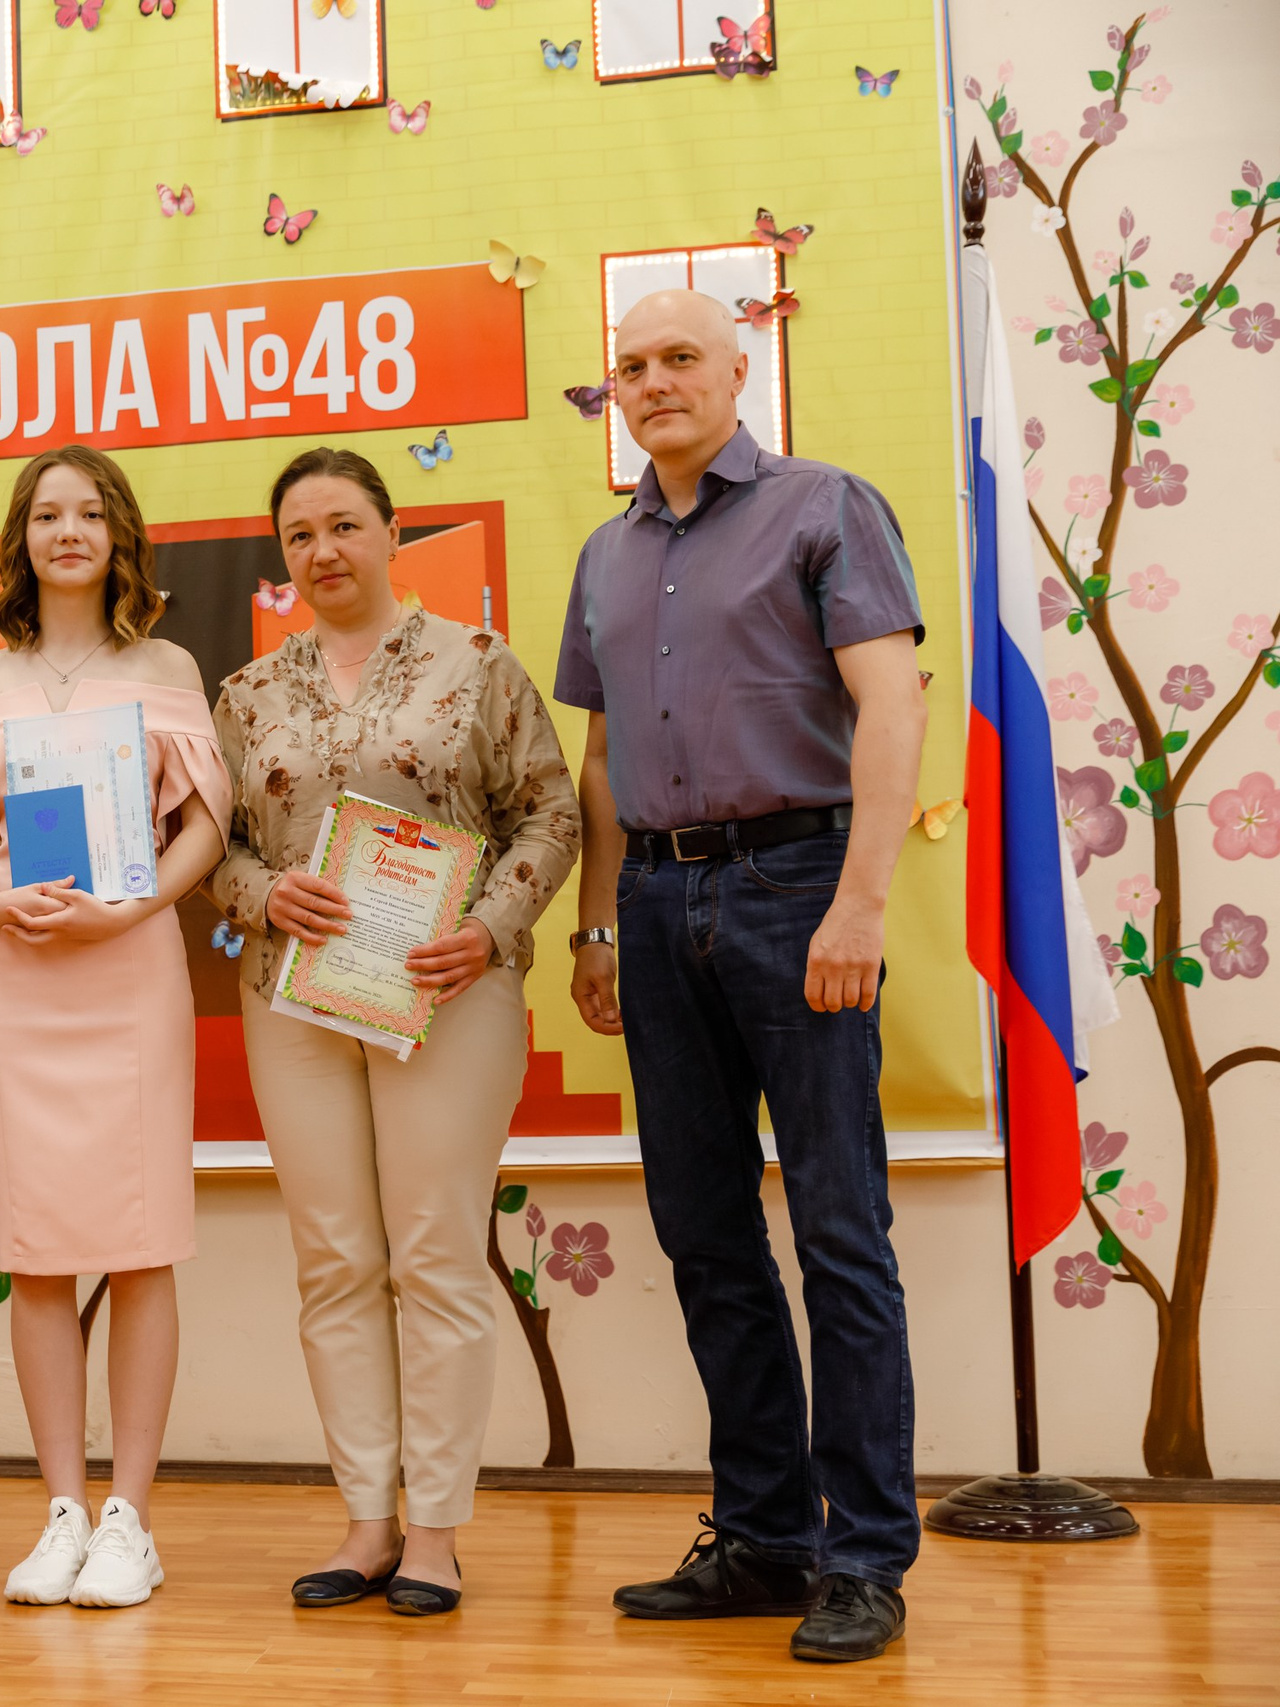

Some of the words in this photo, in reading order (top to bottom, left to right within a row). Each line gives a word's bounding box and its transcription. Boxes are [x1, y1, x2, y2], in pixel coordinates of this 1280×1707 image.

[188, 296, 417, 426] №48
[361, 840, 437, 880] Благодарность
[374, 867, 418, 886] родителям
